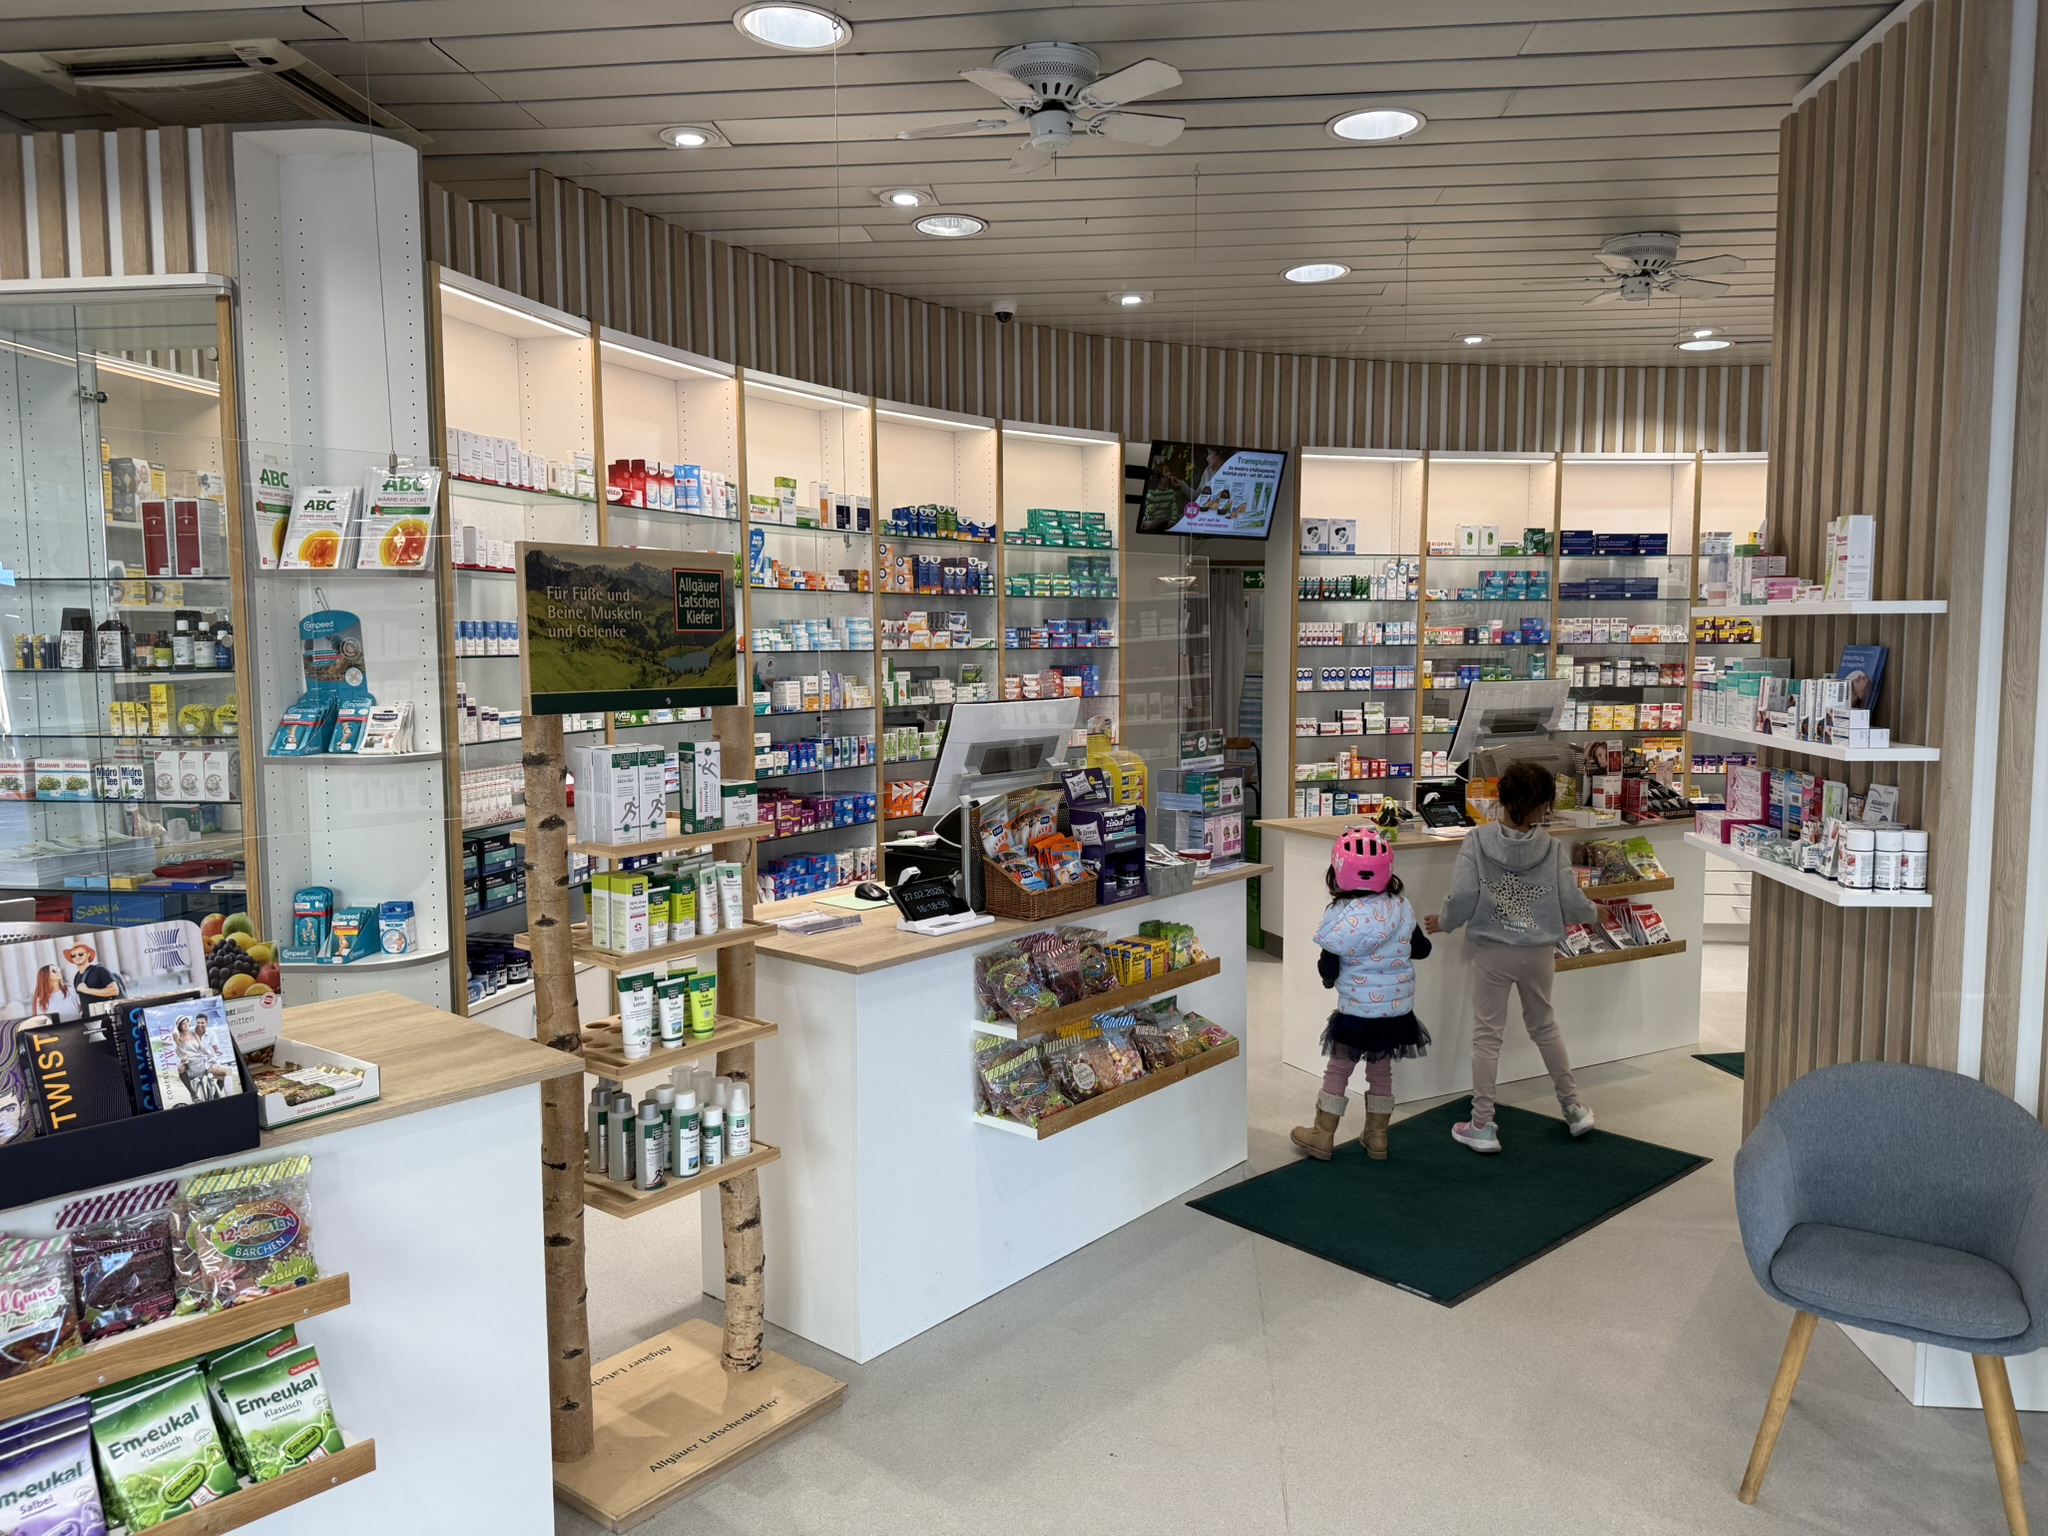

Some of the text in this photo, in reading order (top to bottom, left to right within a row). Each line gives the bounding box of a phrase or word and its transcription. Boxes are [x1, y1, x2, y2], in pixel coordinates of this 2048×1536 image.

[1237, 456, 1279, 467] Transpulmin
[259, 468, 290, 489] ABC
[382, 476, 425, 492] ABC
[304, 500, 336, 511] ABC
[1186, 506, 1198, 514] NEU
[546, 585, 630, 601] Für Füße und
[679, 577, 719, 597] Allgäuer
[679, 592, 720, 609] Latschen
[547, 605, 642, 621] Beine, Muskeln
[686, 610, 714, 625] Kiefer
[303, 620, 334, 632] Compeed
[548, 624, 627, 638] und Gelenke
[288, 706, 319, 714] Compeed
[342, 700, 370, 710] Compeed
[615, 711, 631, 720] Kytta
[612, 753, 637, 764] MOBIL
[640, 751, 665, 761] MOBIL
[96, 767, 118, 777] Midro
[121, 767, 142, 777] Midro
[105, 777, 118, 785] Tee
[131, 776, 143, 785] Tee
[296, 893, 324, 902] Compeed
[903, 887, 945, 901] 27.02.2026
[916, 900, 949, 913] 16:18:50
[333, 912, 360, 922] Compeed
[144, 943, 188, 954] COMPRESSANA
[282, 949, 309, 958] Compeed
[160, 1026, 177, 1068] TWIST
[33, 1034, 77, 1129] TWIST
[159, 1048, 173, 1100] COMPRESSANA
[331, 1095, 355, 1107] Apotheken
[218, 1214, 296, 1243] 12-SORTEN
[235, 1237, 285, 1257] BÄRCHEN
[271, 1260, 310, 1283] sauer!
[628, 1345, 672, 1370] Allgäuer
[291, 1360, 316, 1375] Zuckerfrei
[236, 1372, 319, 1415] Em-eukal
[263, 1399, 303, 1419] Klassisch
[108, 1404, 200, 1460] Em-eukal
[140, 1436, 183, 1459] Klassisch
[649, 1443, 699, 1473] Allgäuer
[0, 1461, 84, 1508] m-eukal
[19, 1495, 54, 1515] Salbei
